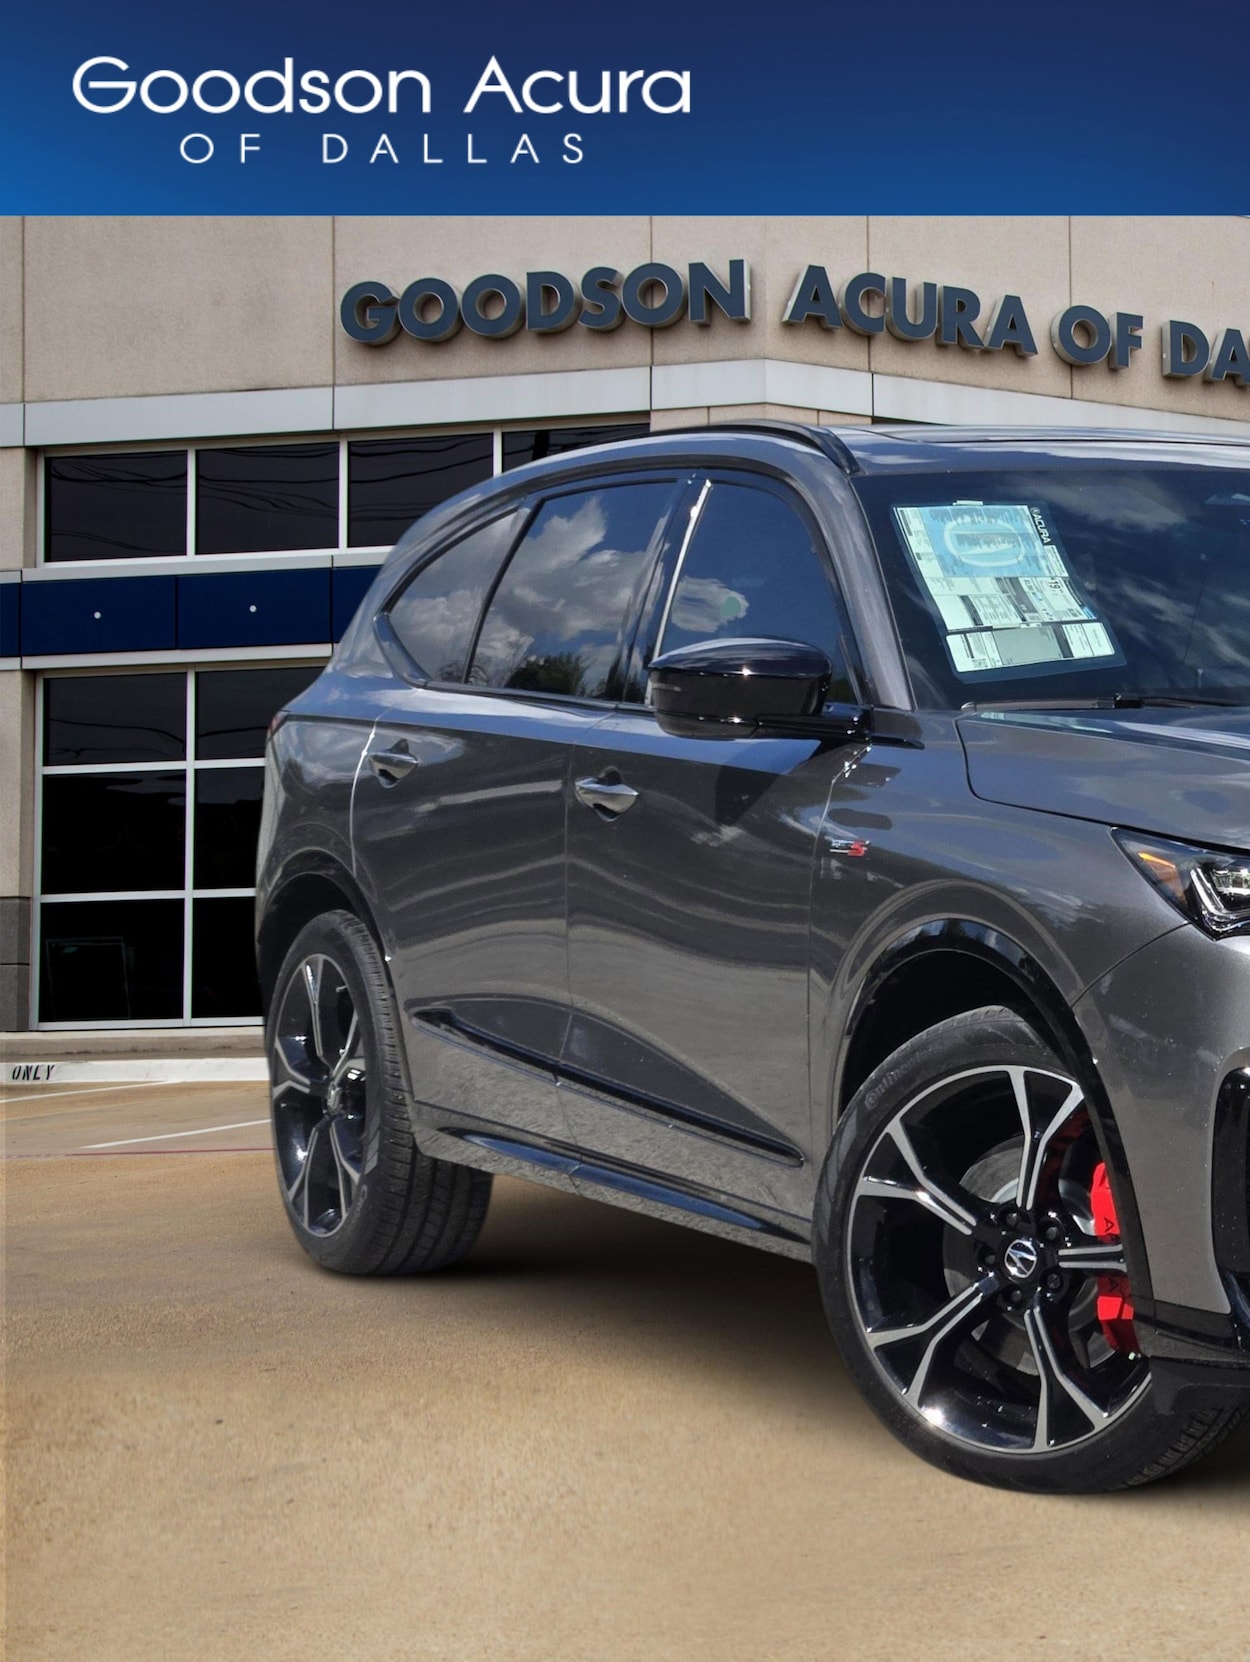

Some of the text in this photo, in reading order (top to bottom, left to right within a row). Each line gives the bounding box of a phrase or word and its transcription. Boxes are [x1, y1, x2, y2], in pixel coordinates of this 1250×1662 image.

[340, 258, 751, 346] GOODSON
[783, 264, 1038, 356] ACURA
[1051, 305, 1144, 369] OF
[1032, 513, 1051, 543] ACURA
[12, 1065, 54, 1081] ONLY
